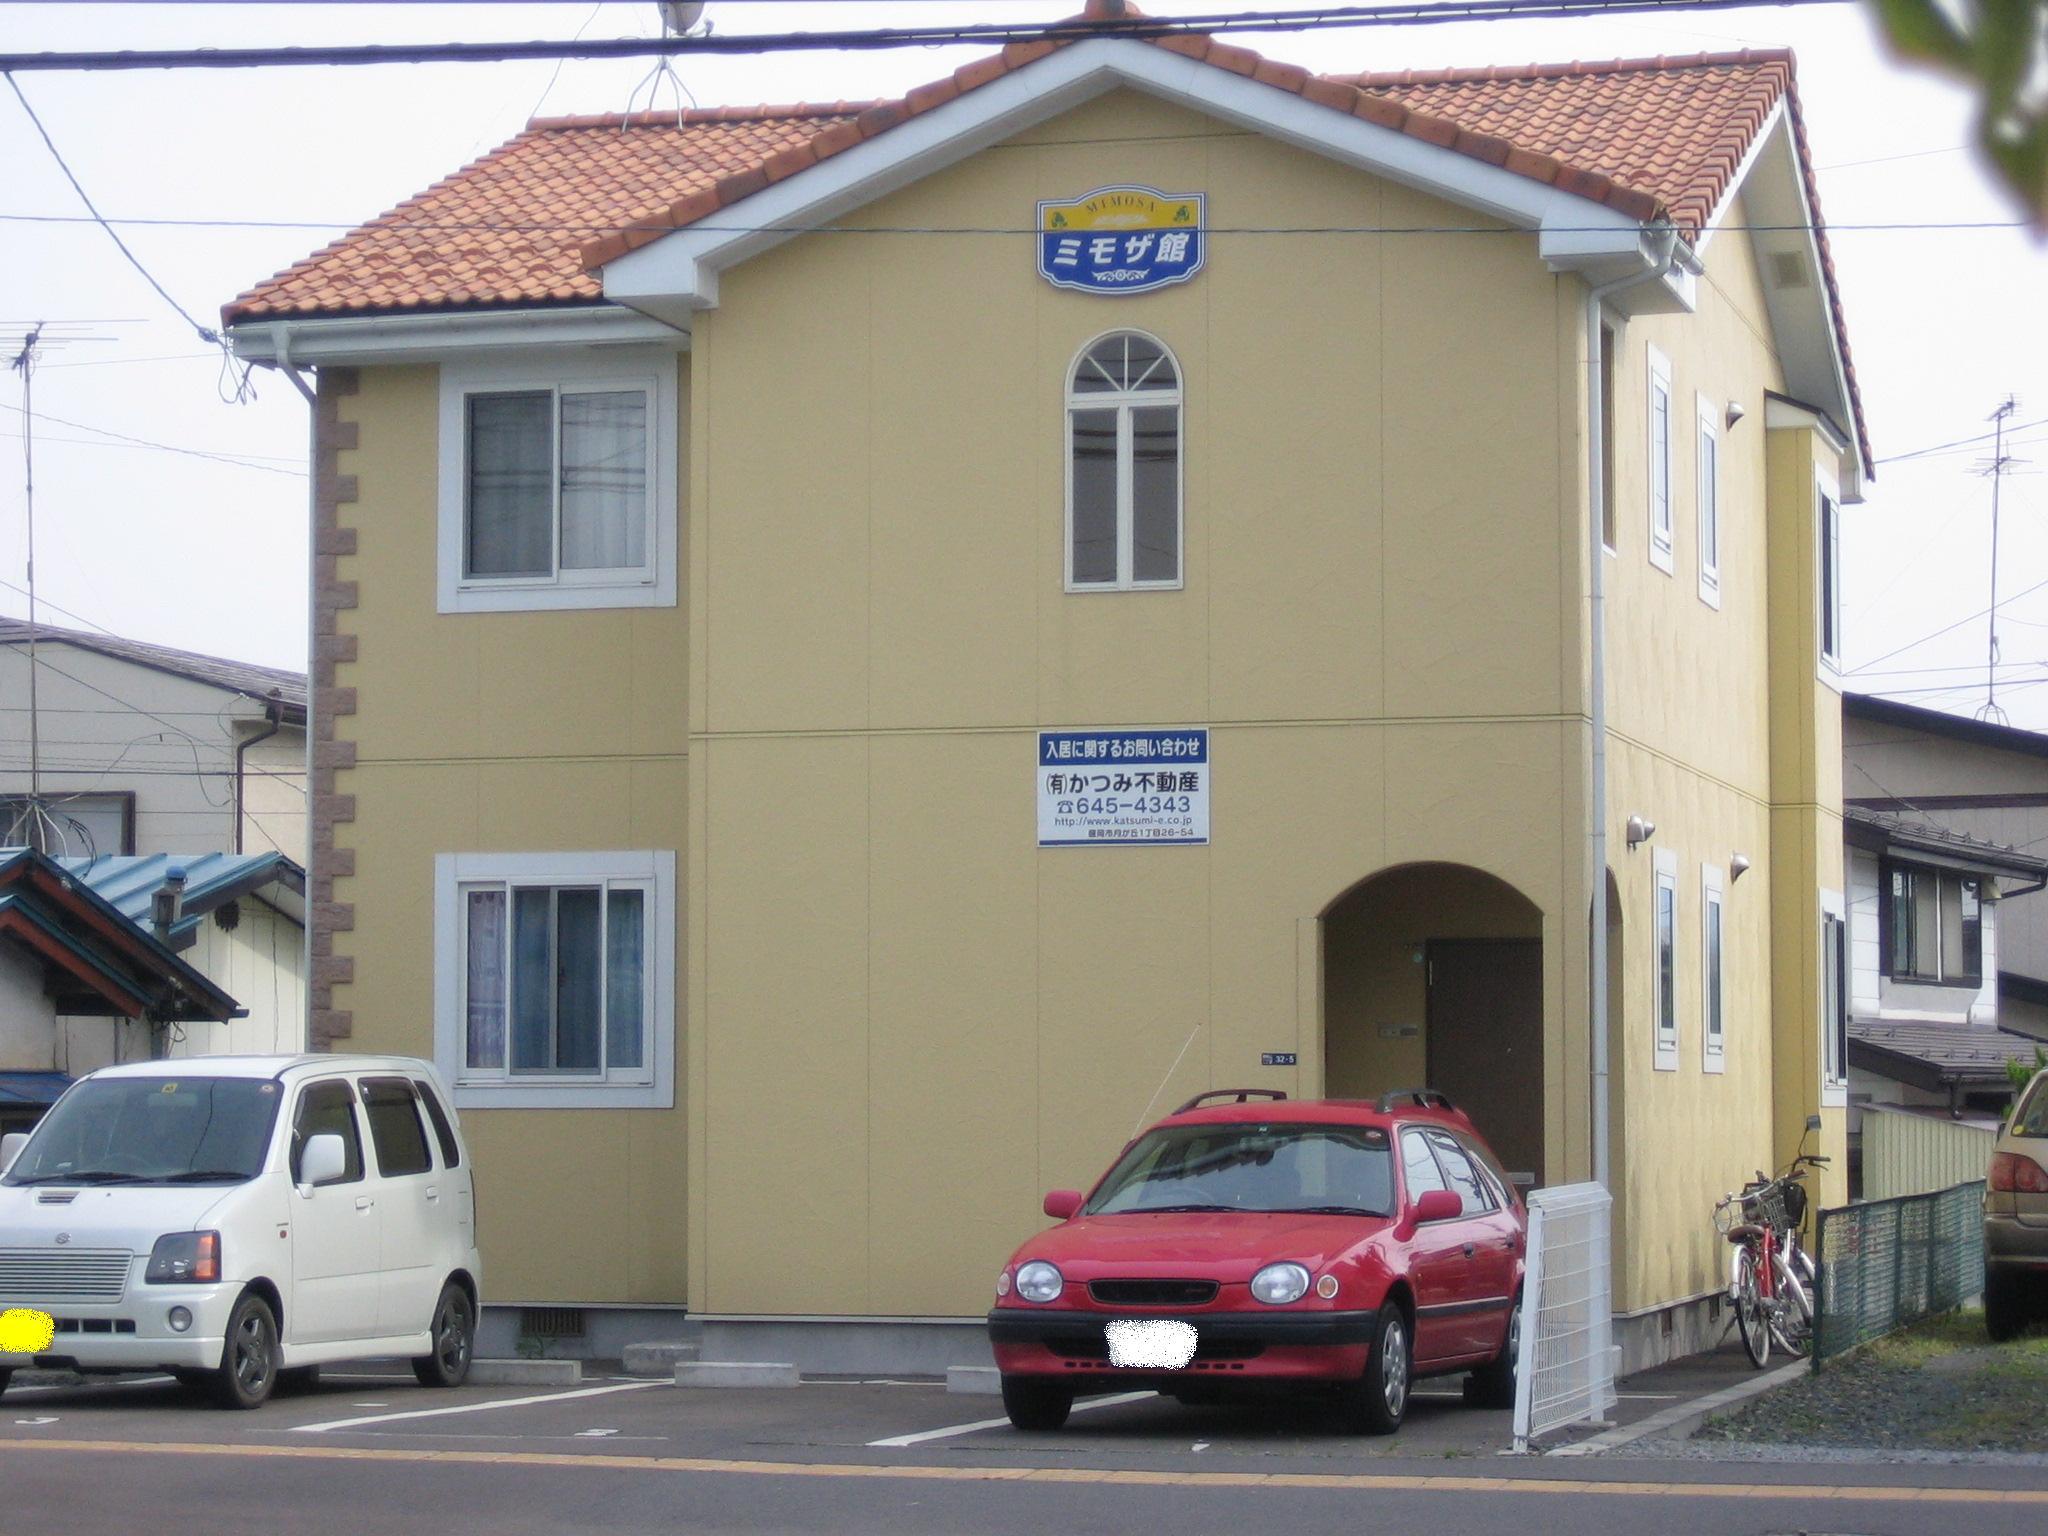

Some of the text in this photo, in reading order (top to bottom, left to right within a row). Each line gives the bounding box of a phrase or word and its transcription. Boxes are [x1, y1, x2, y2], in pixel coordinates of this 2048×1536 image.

[1053, 232, 1190, 266] ミモザ館
[1046, 737, 1200, 759] 入居に関するお問い合わせ
[1054, 815, 1193, 828] http://www.katsumi-e.co.jp
